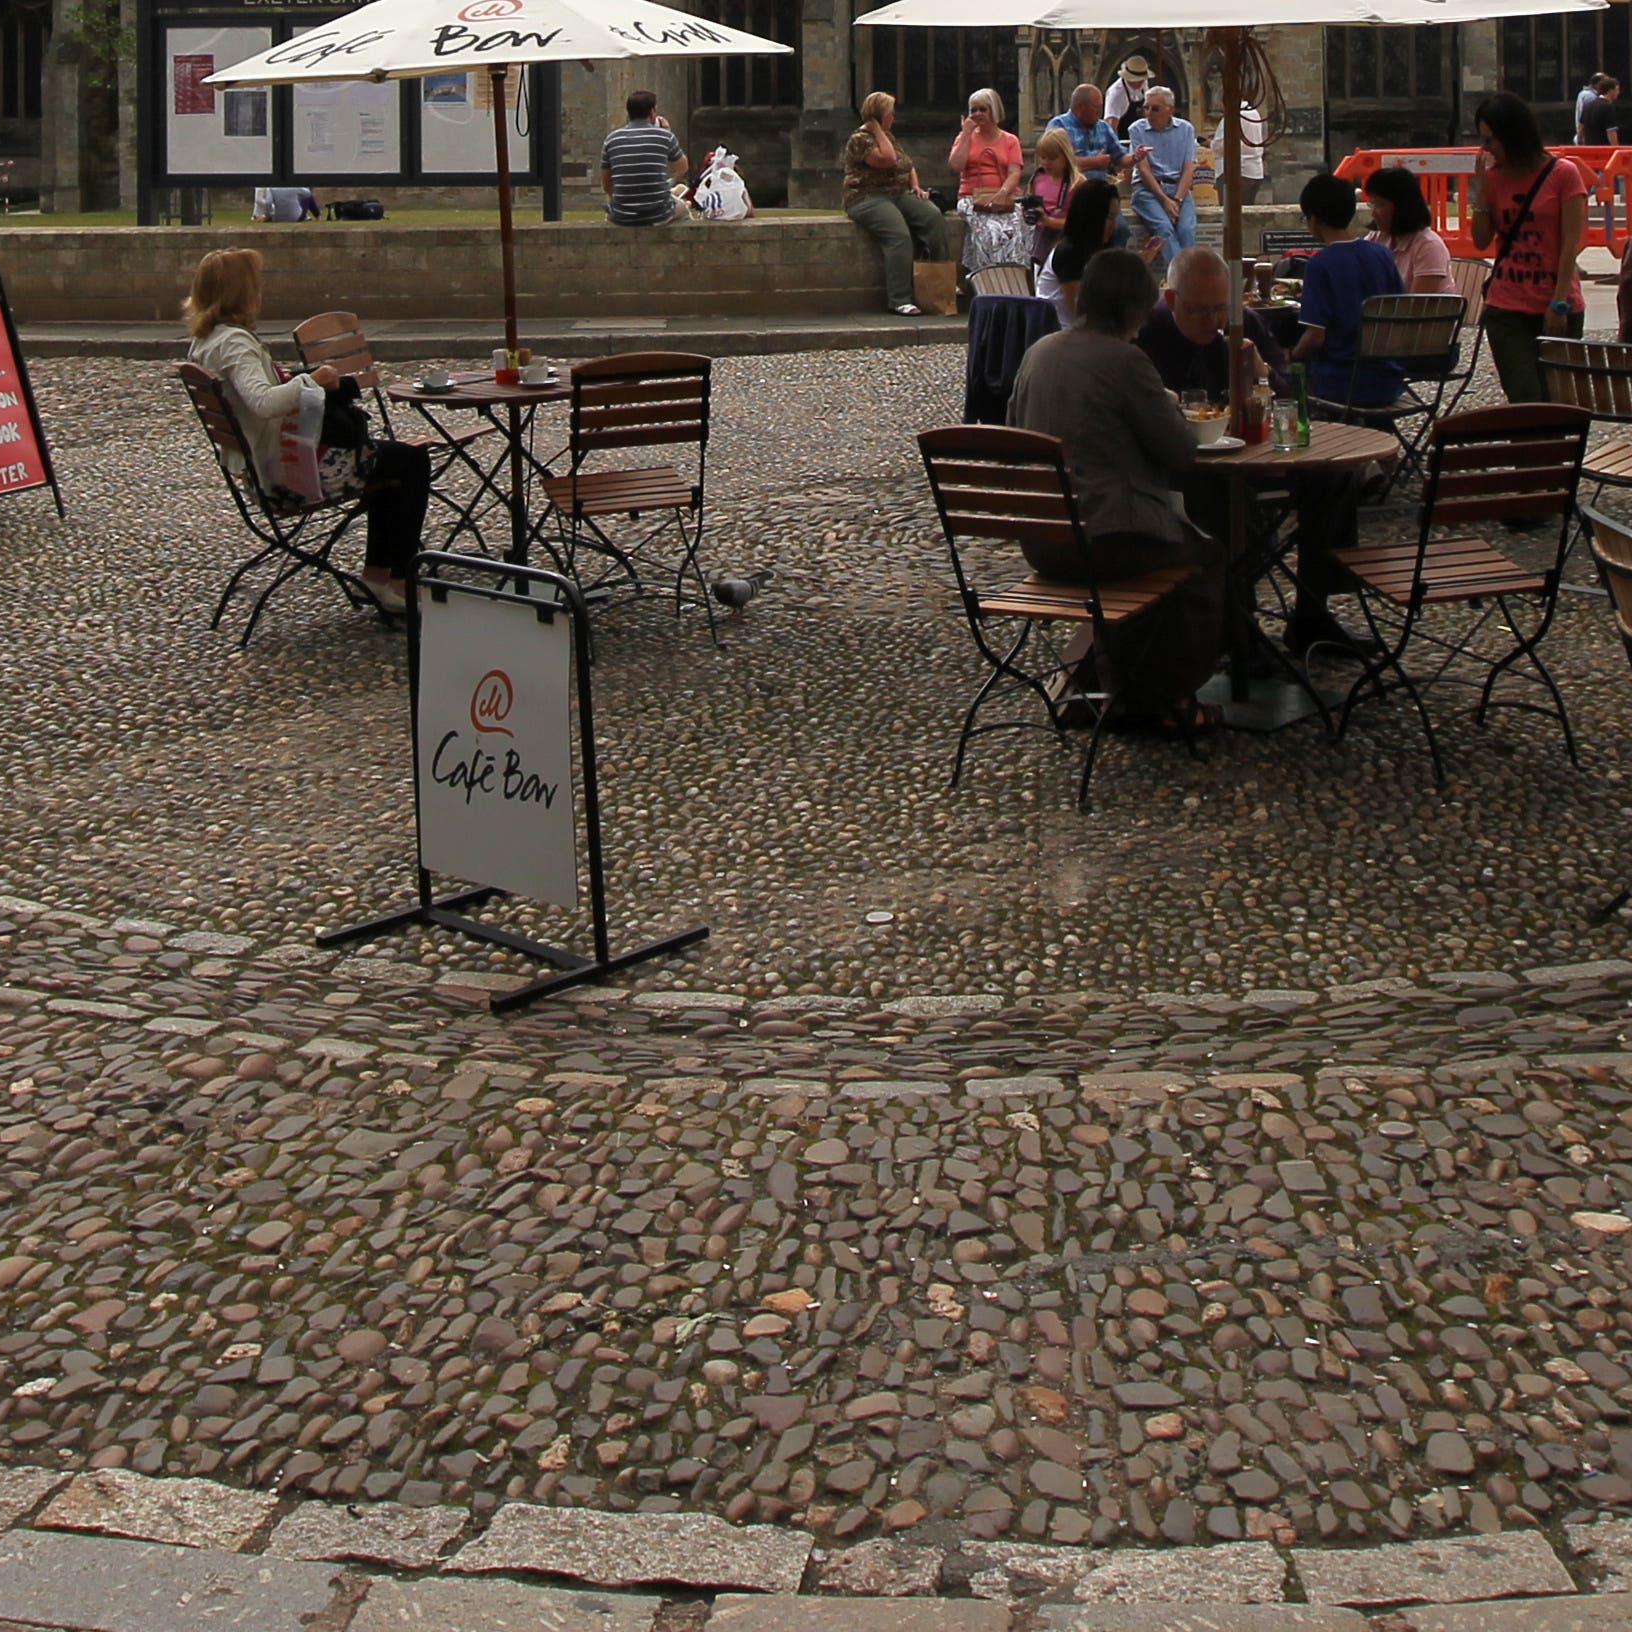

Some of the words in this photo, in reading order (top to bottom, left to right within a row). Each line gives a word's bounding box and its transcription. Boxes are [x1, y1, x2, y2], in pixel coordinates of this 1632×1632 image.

[267, 29, 396, 68] Café
[429, 24, 572, 57] Bar
[633, 21, 732, 47] Grill
[432, 730, 496, 805] Café
[503, 748, 559, 809] Bar
